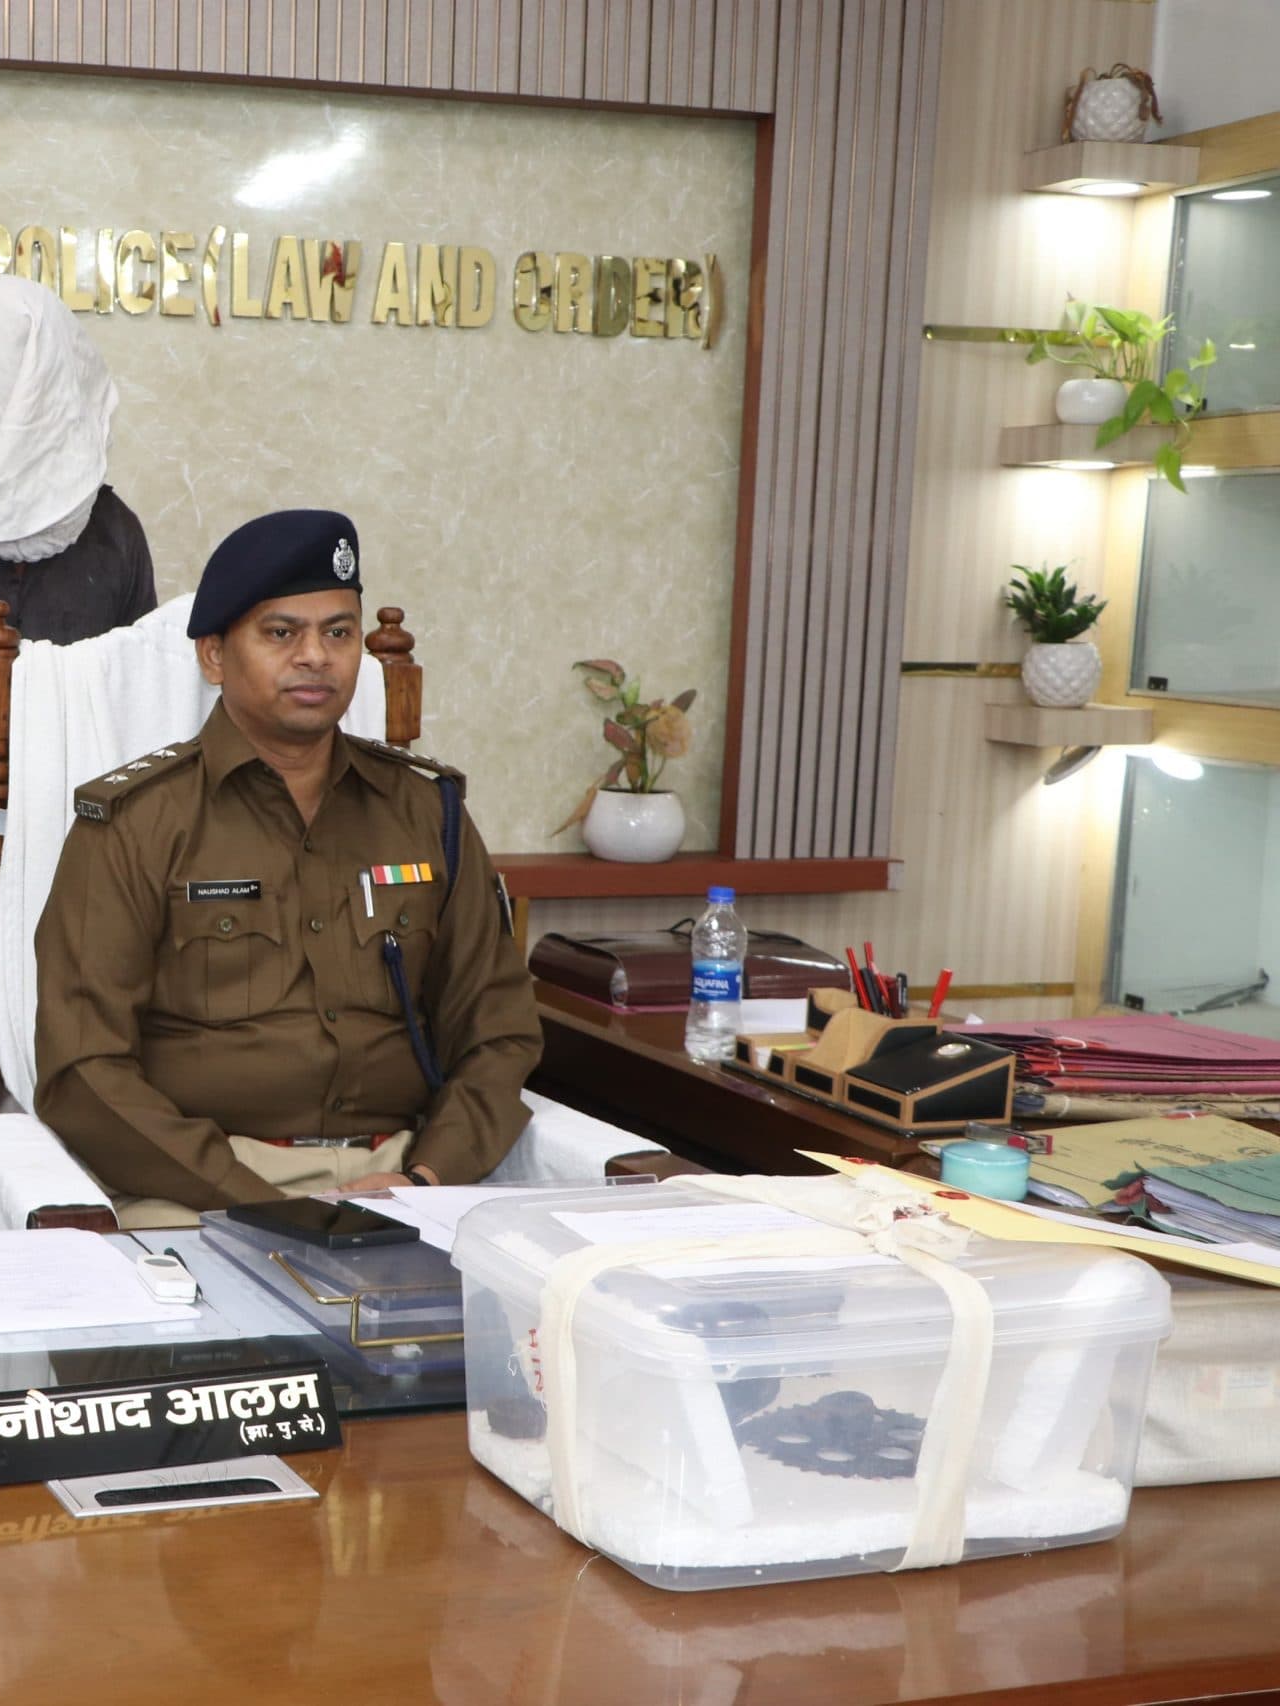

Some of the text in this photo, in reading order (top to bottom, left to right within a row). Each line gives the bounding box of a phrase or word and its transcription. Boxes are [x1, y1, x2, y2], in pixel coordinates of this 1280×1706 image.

[371, 240, 496, 328] AND
[513, 251, 725, 350] ORDER)
[198, 888, 230, 896] NAUSHAD
[231, 887, 250, 895] ALAM
[165, 1373, 320, 1425] आलम
